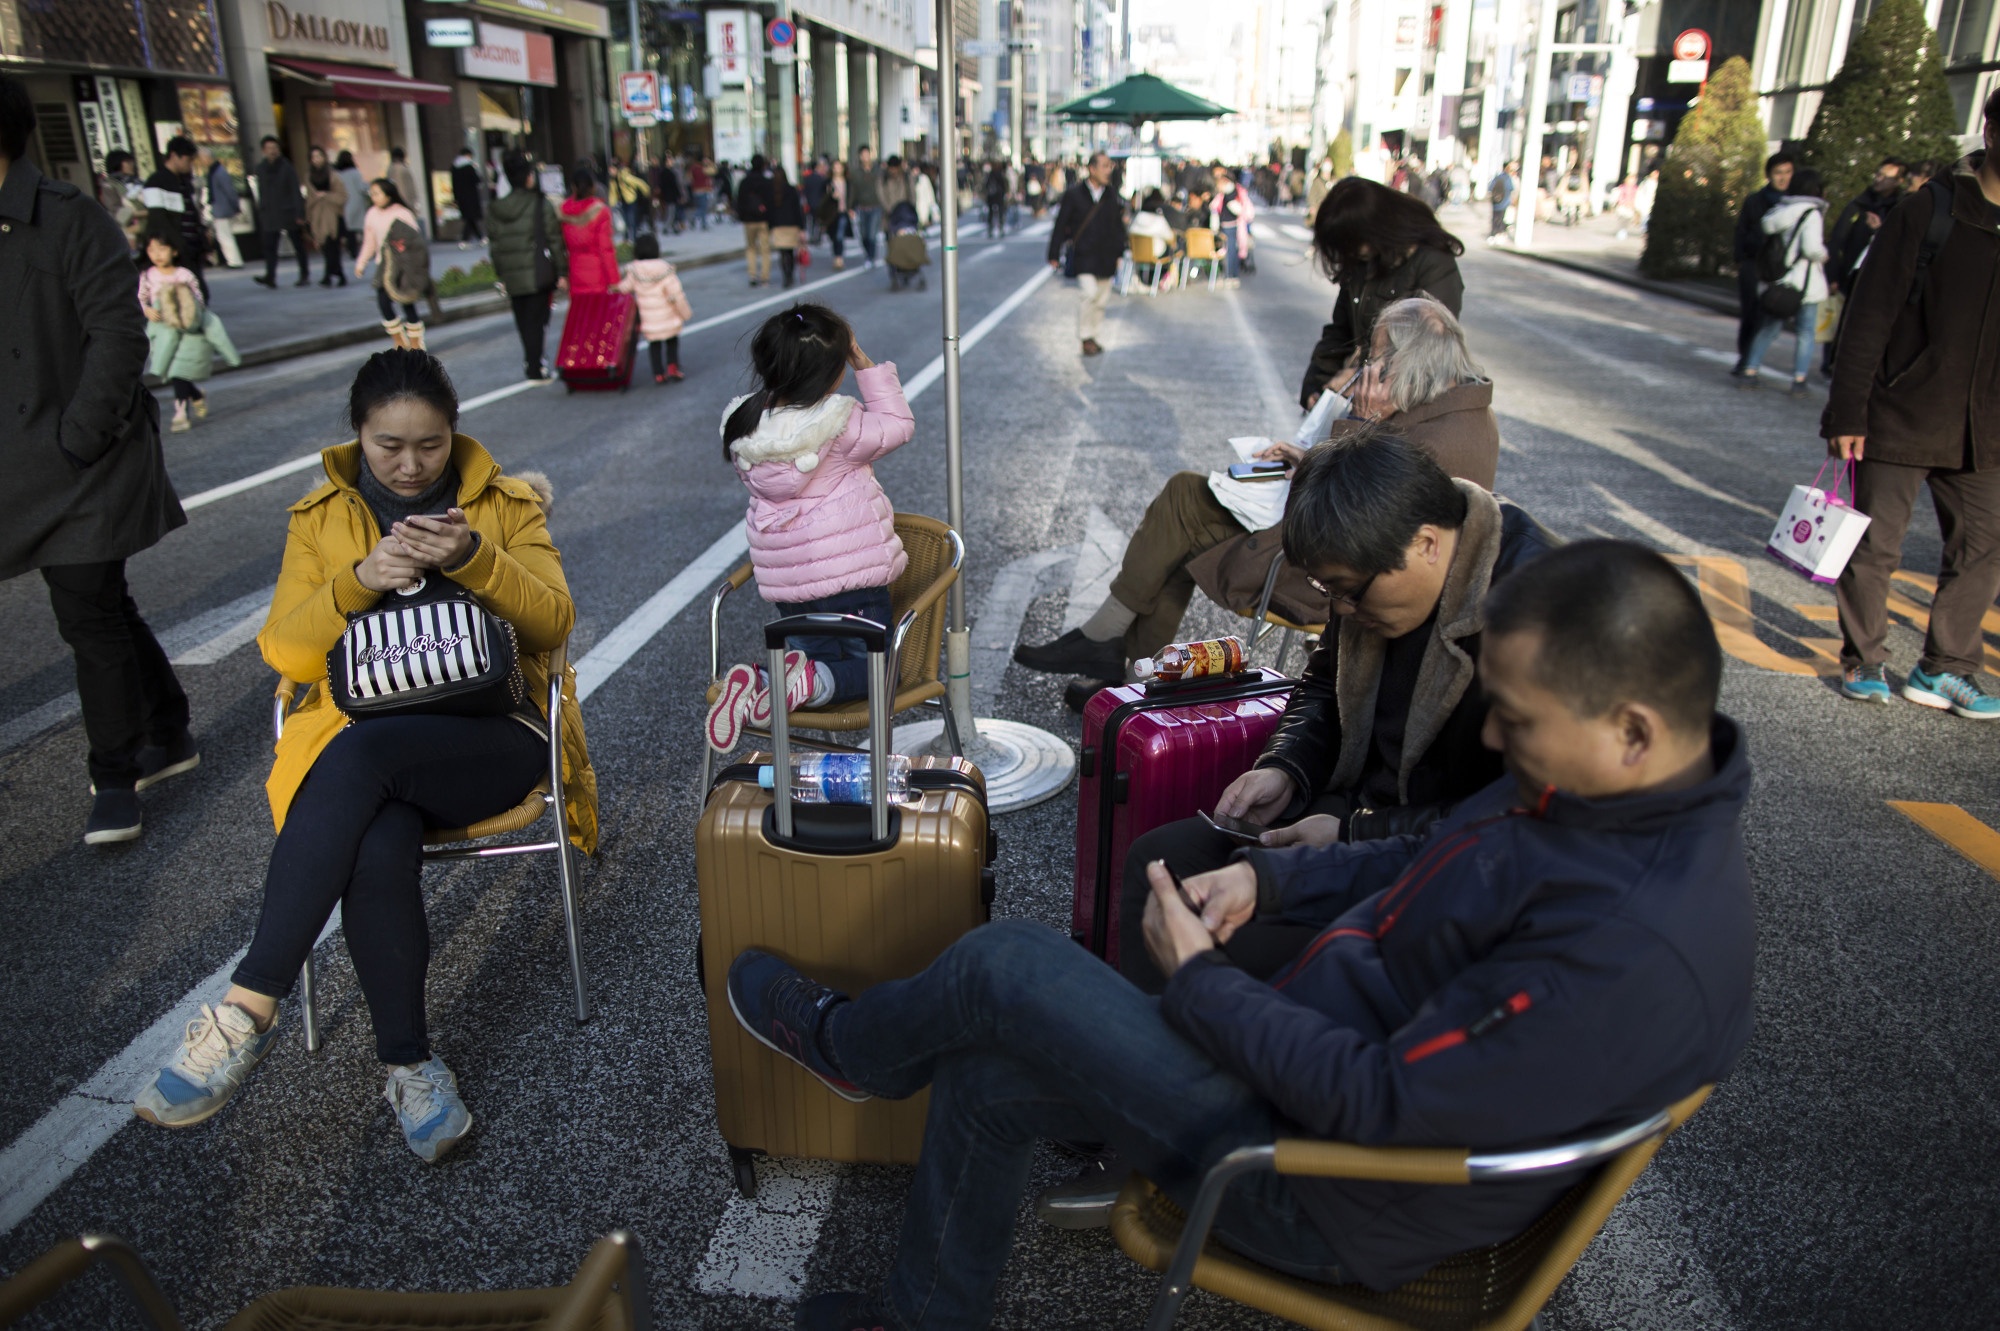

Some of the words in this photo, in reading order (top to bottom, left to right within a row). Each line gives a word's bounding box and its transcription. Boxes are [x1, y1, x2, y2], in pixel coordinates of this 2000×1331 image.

[264, 1, 388, 52] DALLOYAU
[357, 644, 410, 667] Betty
[409, 632, 462, 655] Boop
